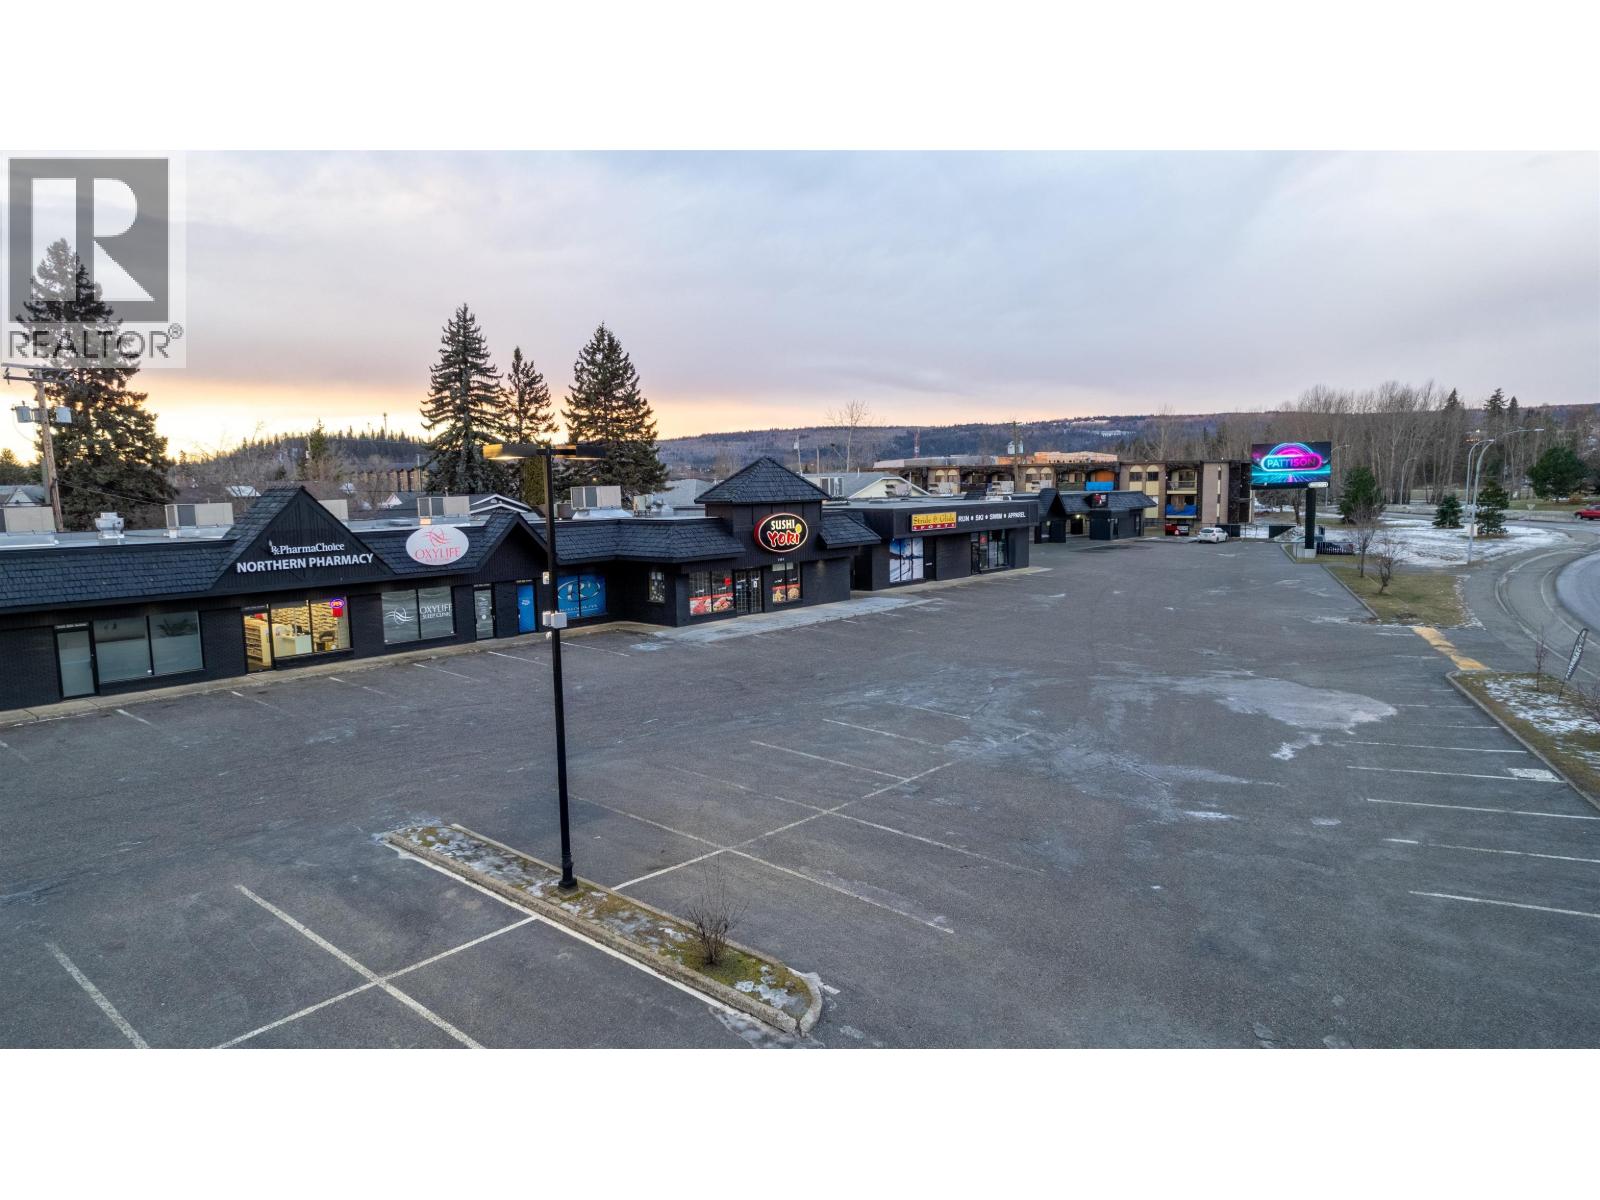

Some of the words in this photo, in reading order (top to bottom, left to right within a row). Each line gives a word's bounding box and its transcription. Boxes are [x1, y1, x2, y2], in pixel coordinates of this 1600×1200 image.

[1266, 456, 1316, 468] PATTISON
[771, 519, 795, 530] SUSHI
[766, 530, 800, 547] YORI
[415, 547, 461, 561] OXYLIFE
[236, 558, 306, 573] NORTHERN
[308, 553, 374, 568] PHARMACY
